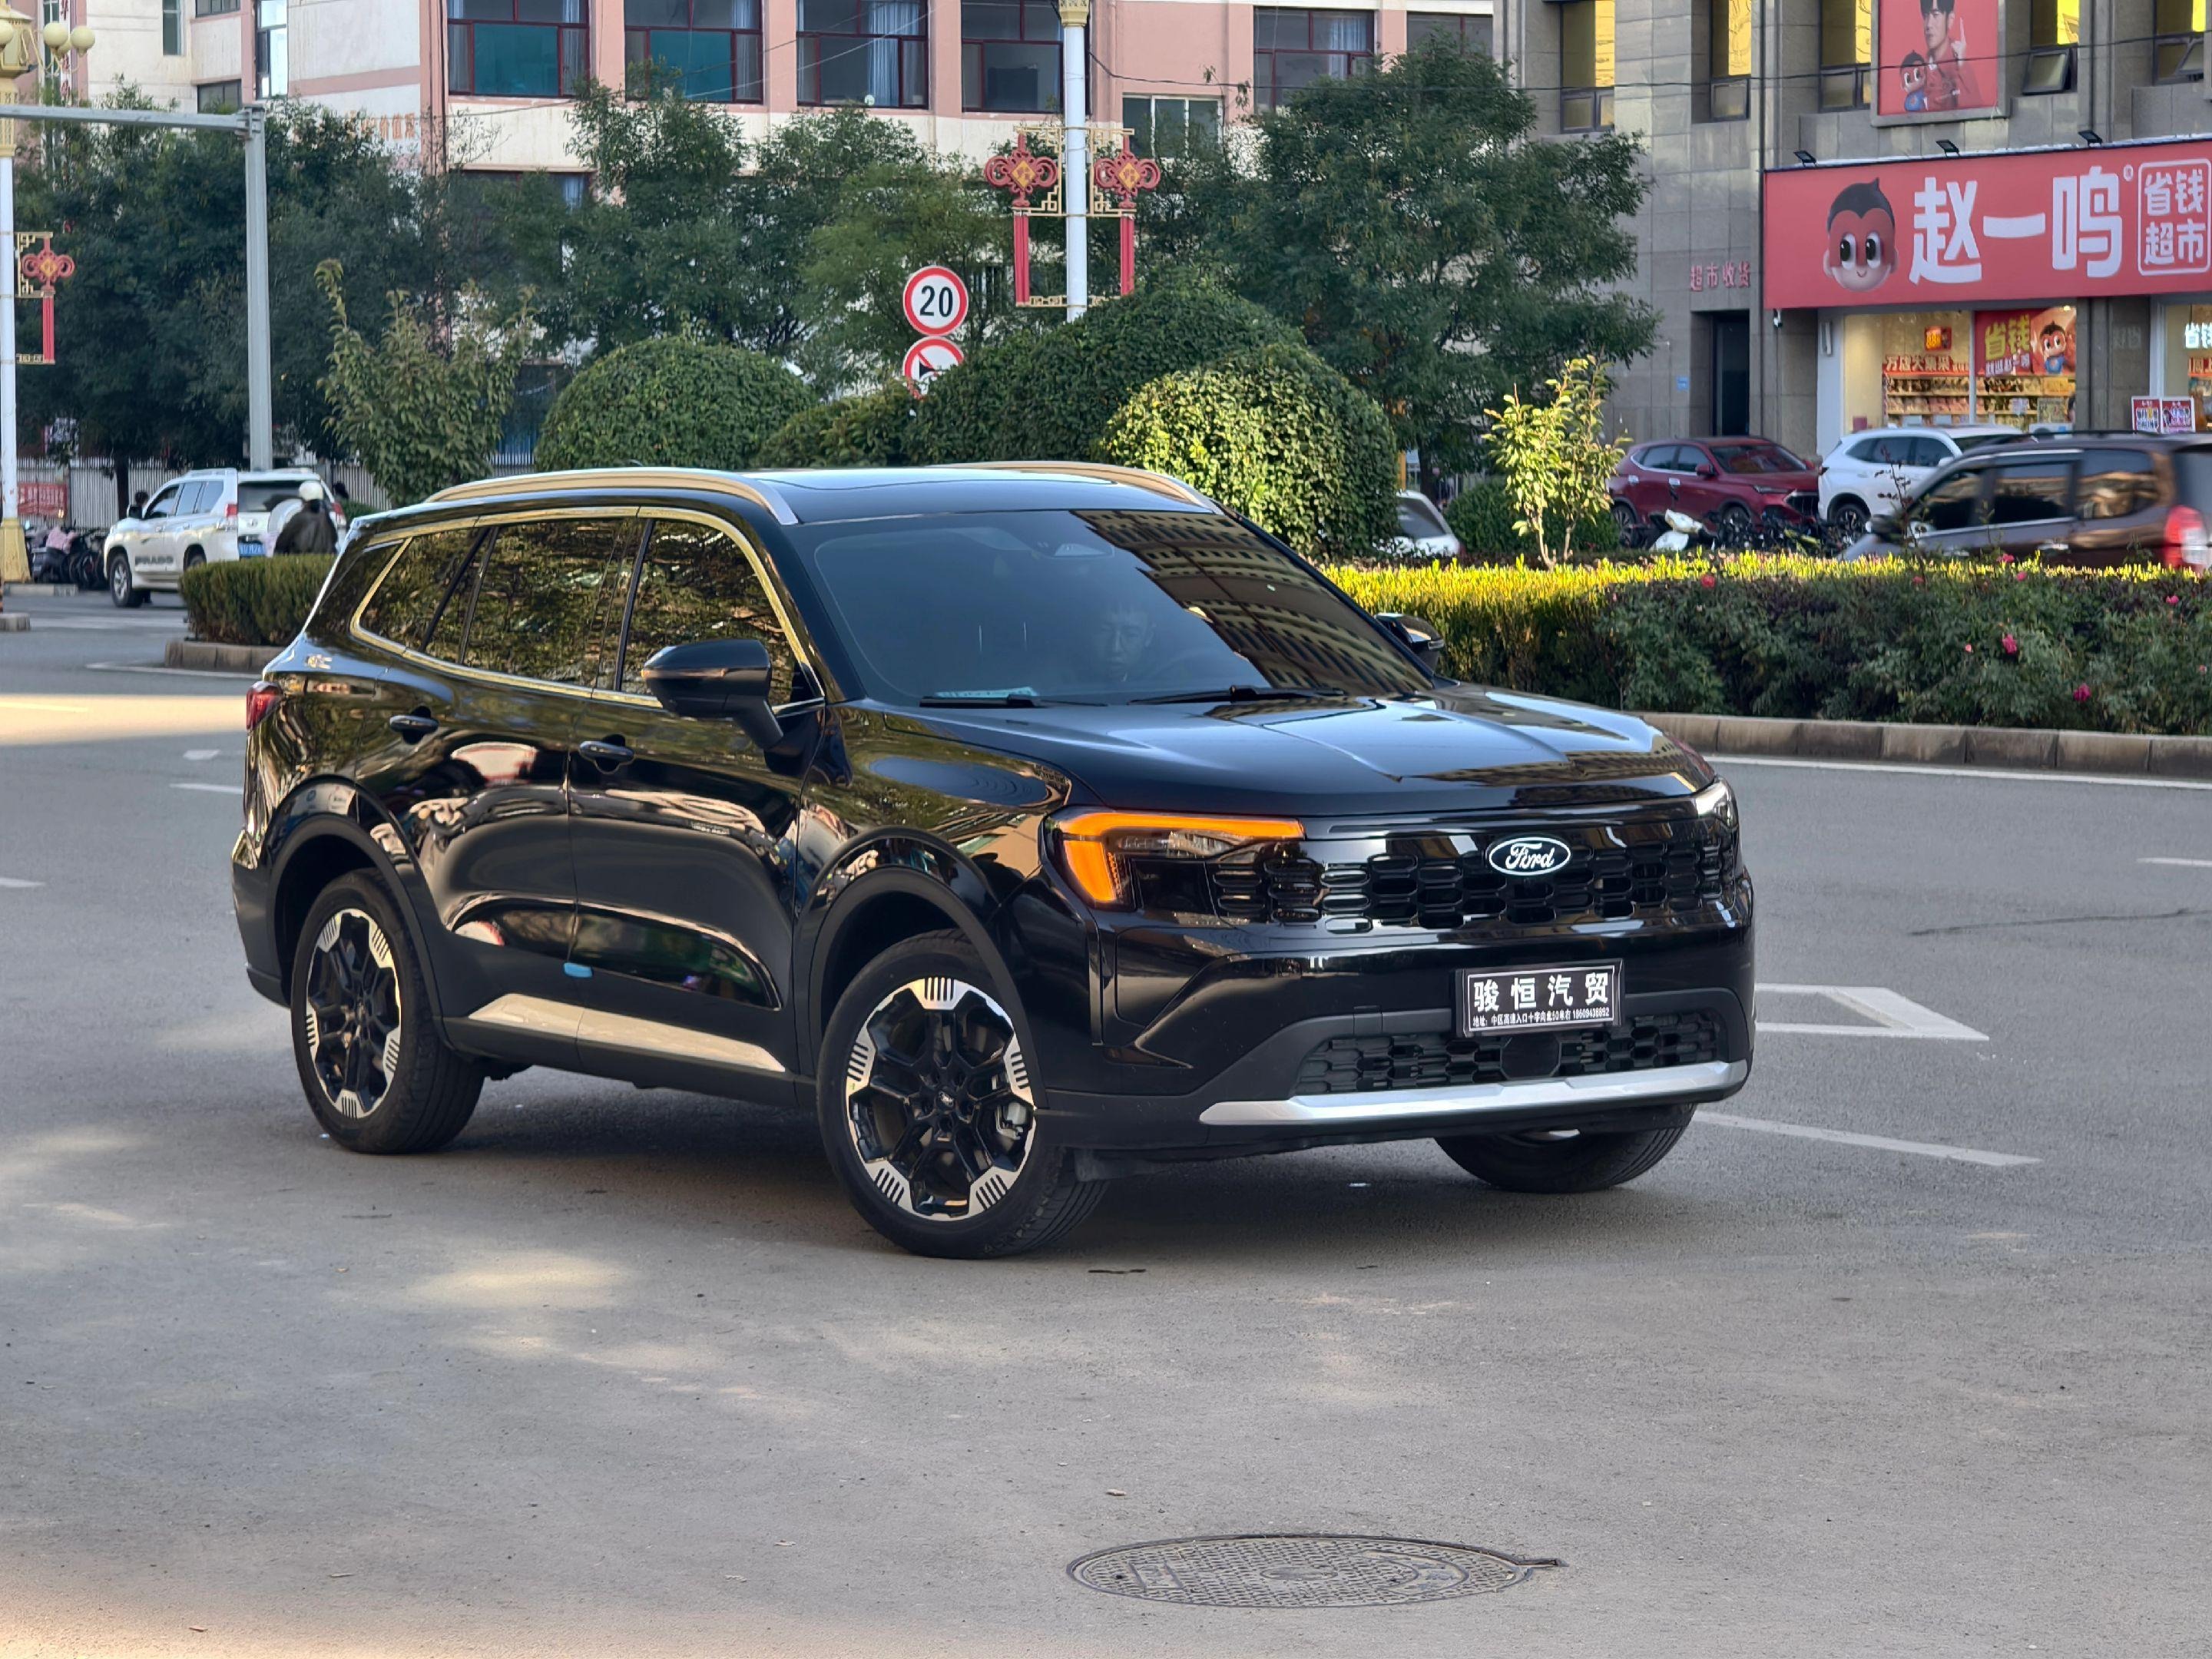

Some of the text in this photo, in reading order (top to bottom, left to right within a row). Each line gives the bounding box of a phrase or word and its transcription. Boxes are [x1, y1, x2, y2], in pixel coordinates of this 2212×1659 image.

[2144, 168, 2204, 217] 省钱
[1909, 165, 2123, 285] 赵一鸣
[2144, 218, 2207, 266] 超市
[919, 285, 954, 317] 20
[1985, 313, 2031, 361] 省钱
[1505, 842, 1555, 869] Ford
[1473, 972, 1608, 1012] 骏恒汽贸
